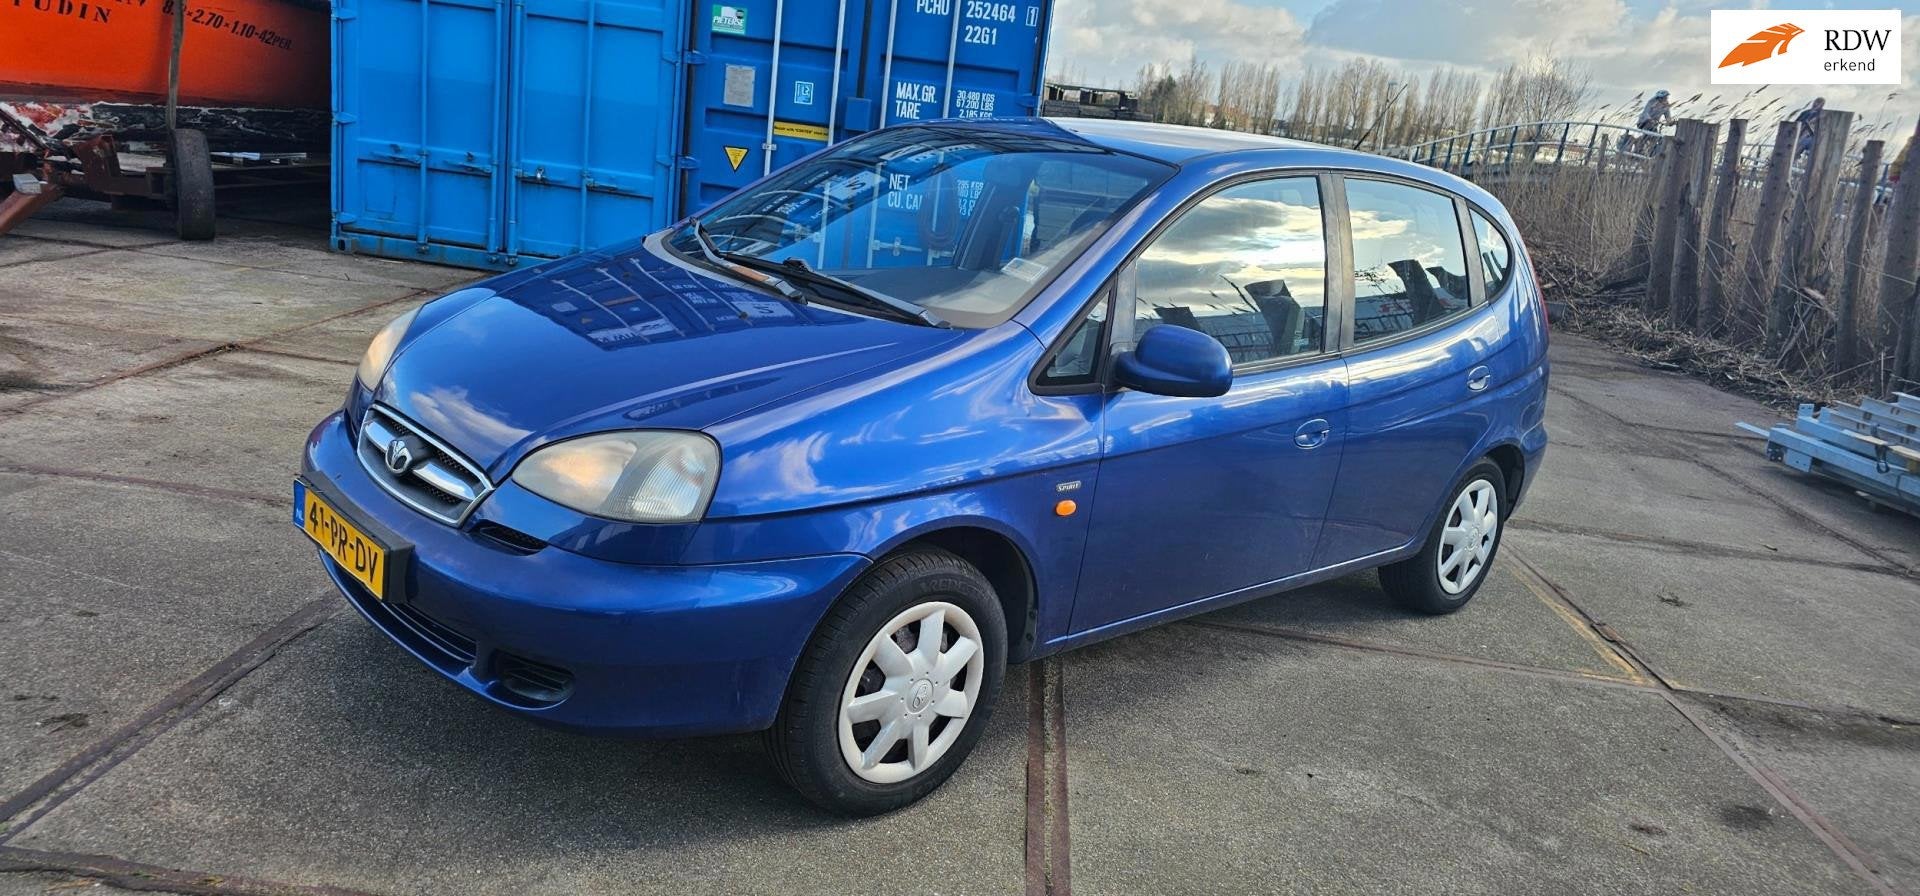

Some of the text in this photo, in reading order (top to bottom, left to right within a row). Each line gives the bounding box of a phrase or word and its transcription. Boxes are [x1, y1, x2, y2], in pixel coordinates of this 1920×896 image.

[966, 1, 1017, 23] 252464
[964, 25, 998, 45] 22G1
[980, 99, 994, 111] LBS
[981, 92, 996, 103] KGS
[895, 100, 922, 120] TARE
[889, 173, 911, 191] NET
[888, 191, 904, 209] CU.
[309, 501, 378, 584] 41-PR-DV
